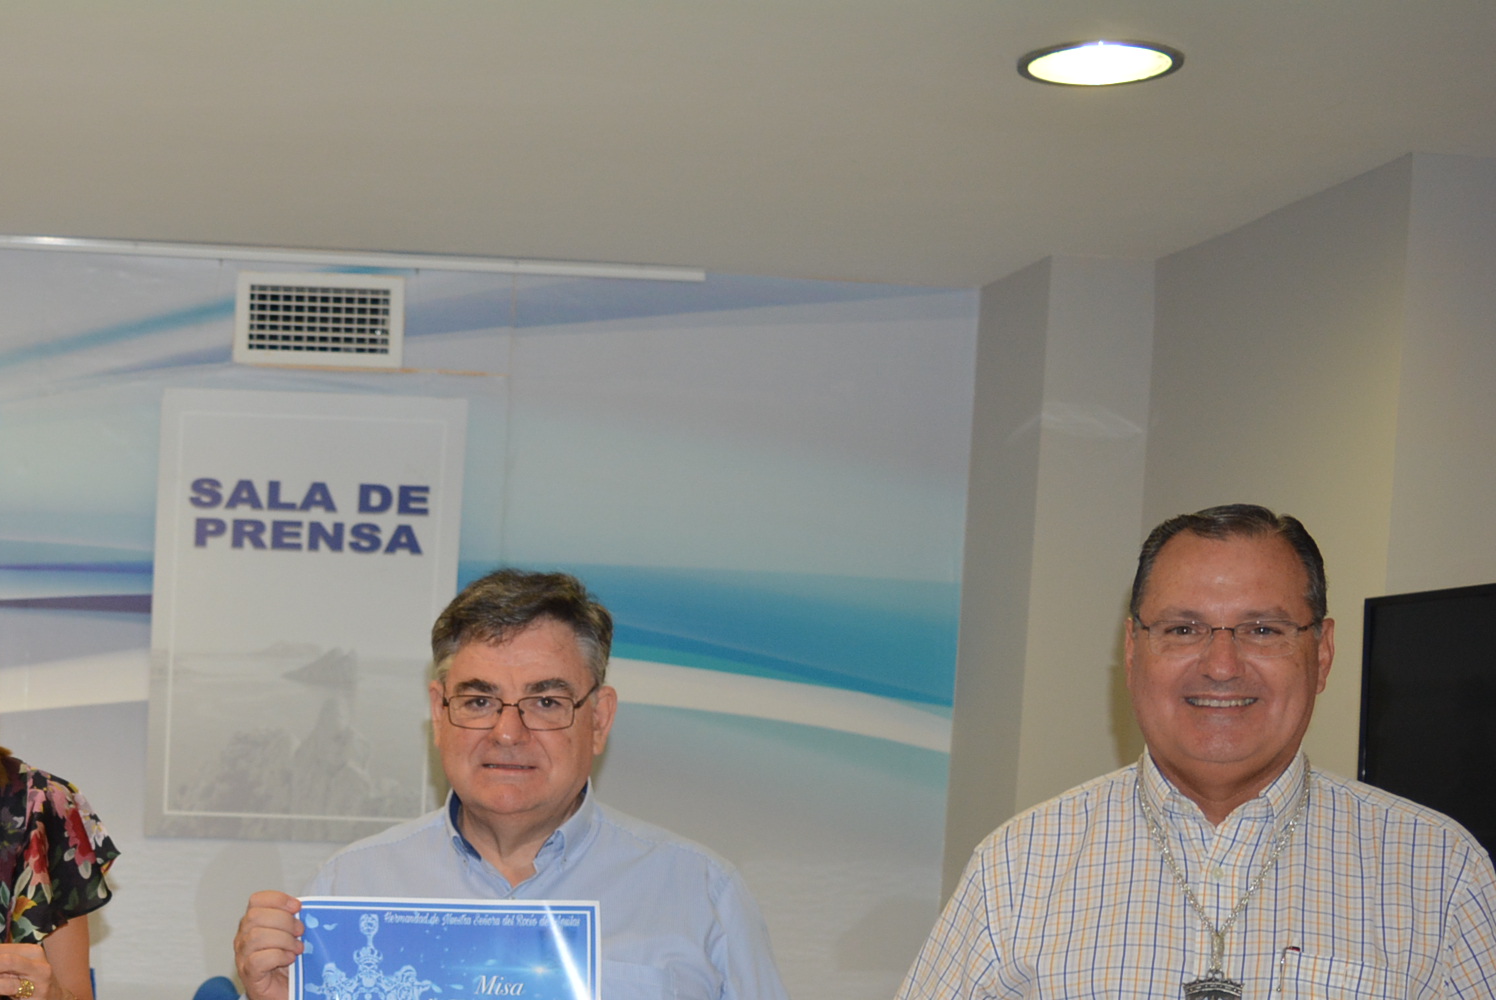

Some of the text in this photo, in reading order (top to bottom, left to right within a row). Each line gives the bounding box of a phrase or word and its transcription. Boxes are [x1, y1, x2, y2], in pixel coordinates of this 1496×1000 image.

[188, 478, 431, 516] SALA DE
[194, 517, 423, 555] PRENSA
[475, 975, 523, 995] Misa
